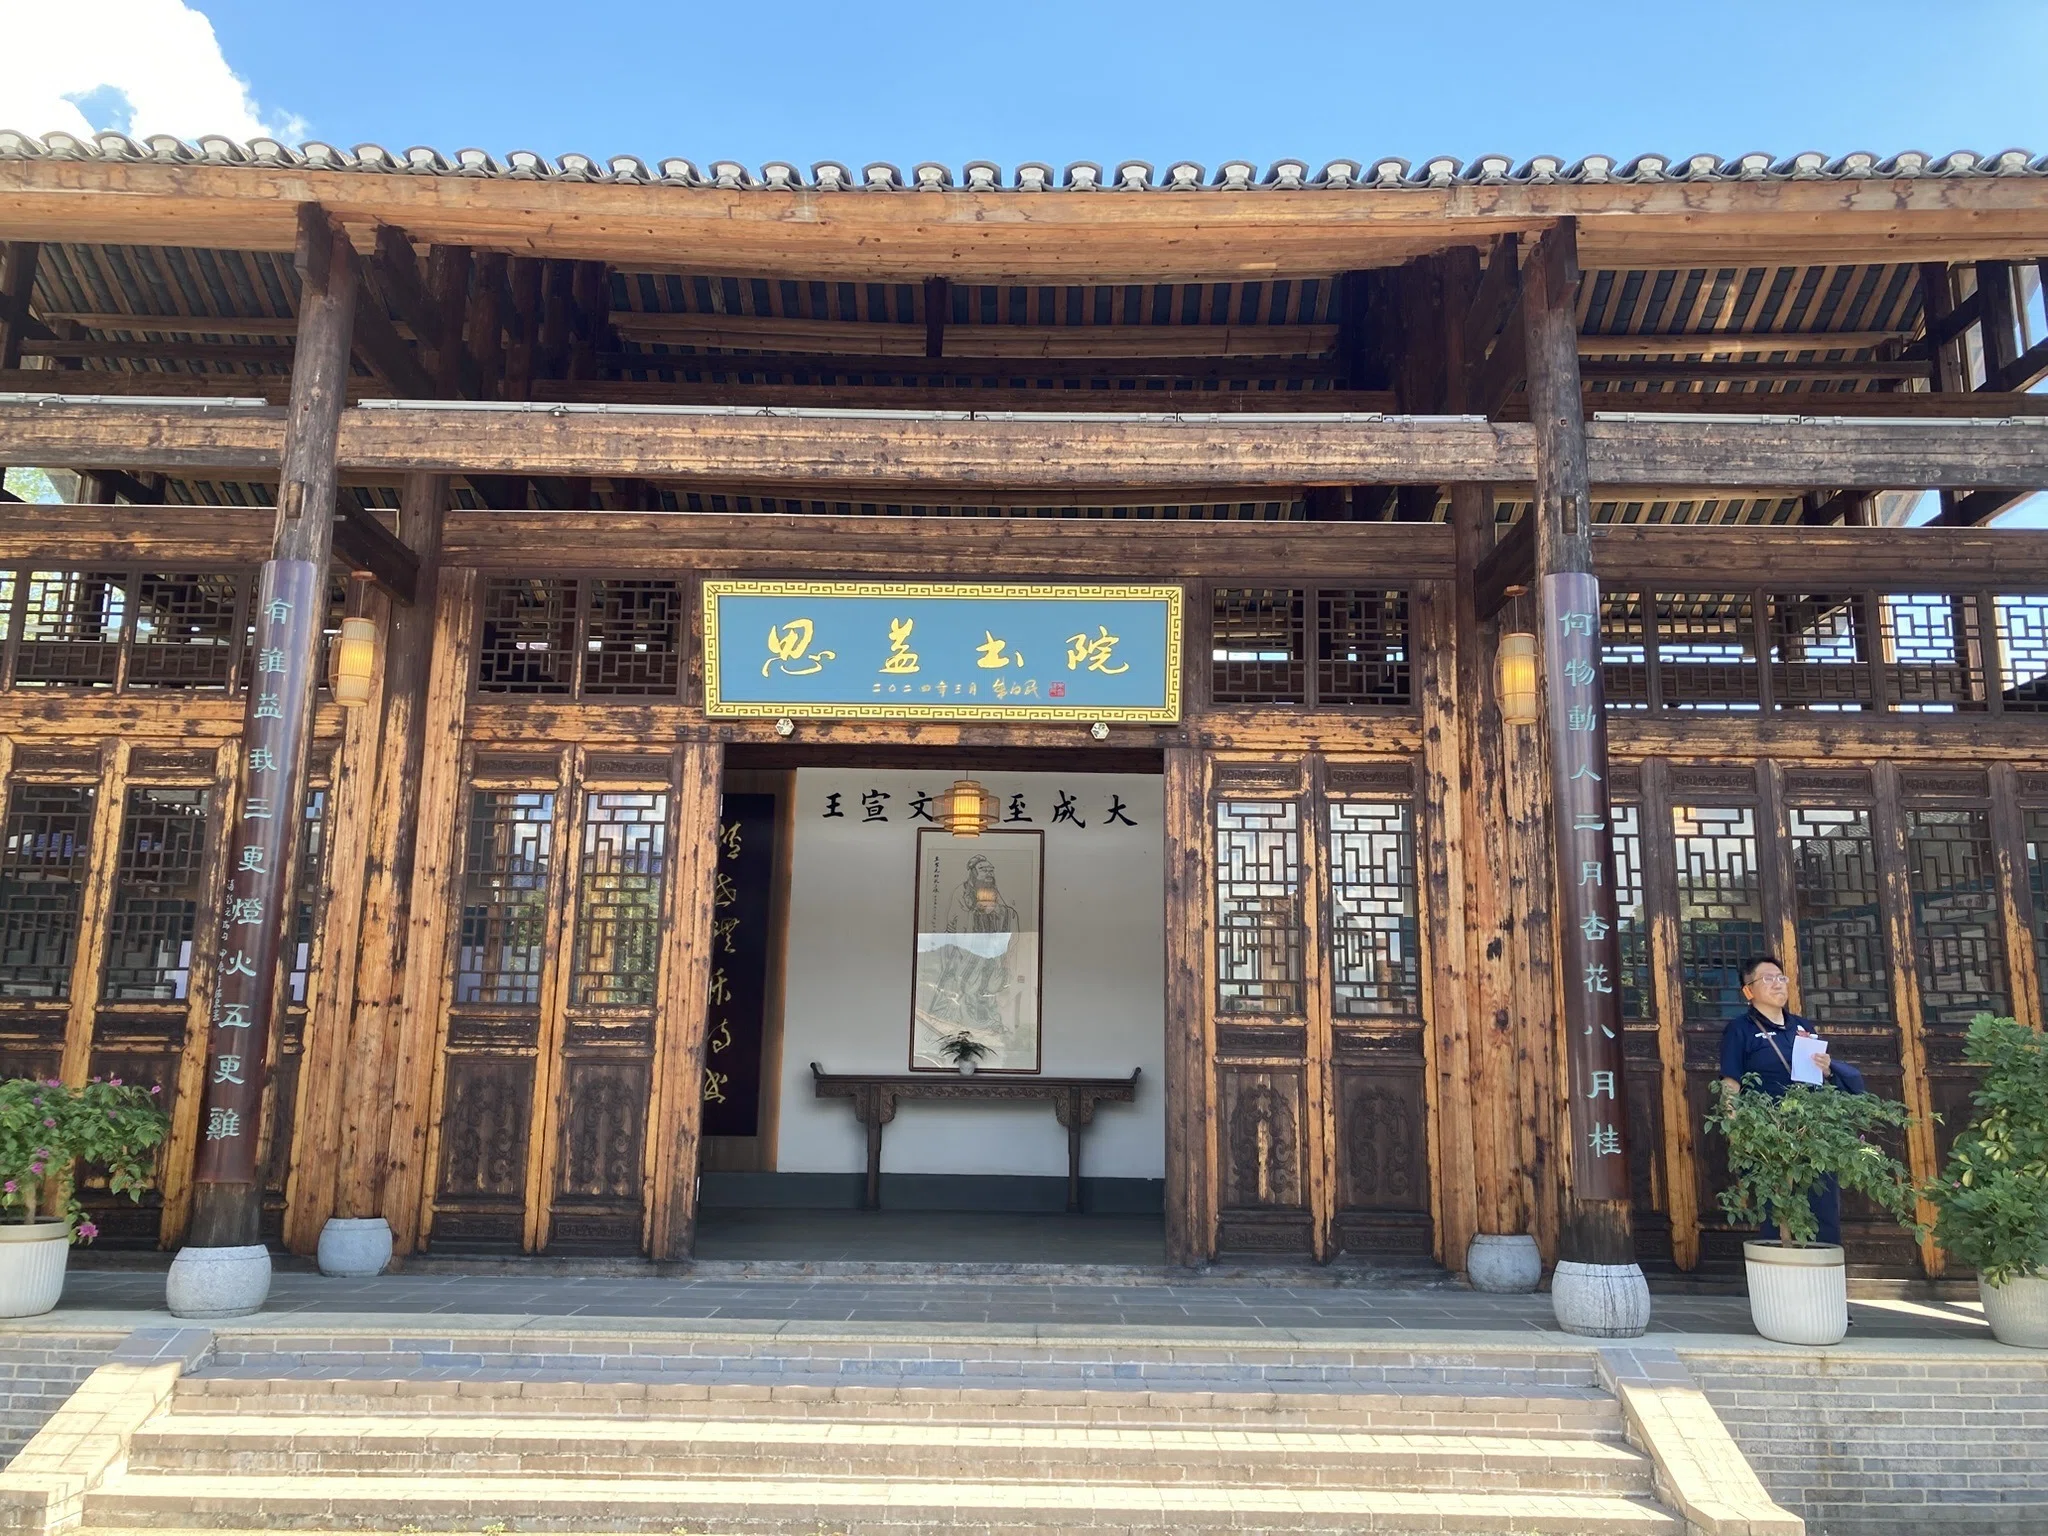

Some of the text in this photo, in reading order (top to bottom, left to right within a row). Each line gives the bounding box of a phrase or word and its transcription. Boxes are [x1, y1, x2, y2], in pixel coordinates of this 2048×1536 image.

[1558, 610, 1622, 1158] 何物動人二月杏花八月桂
